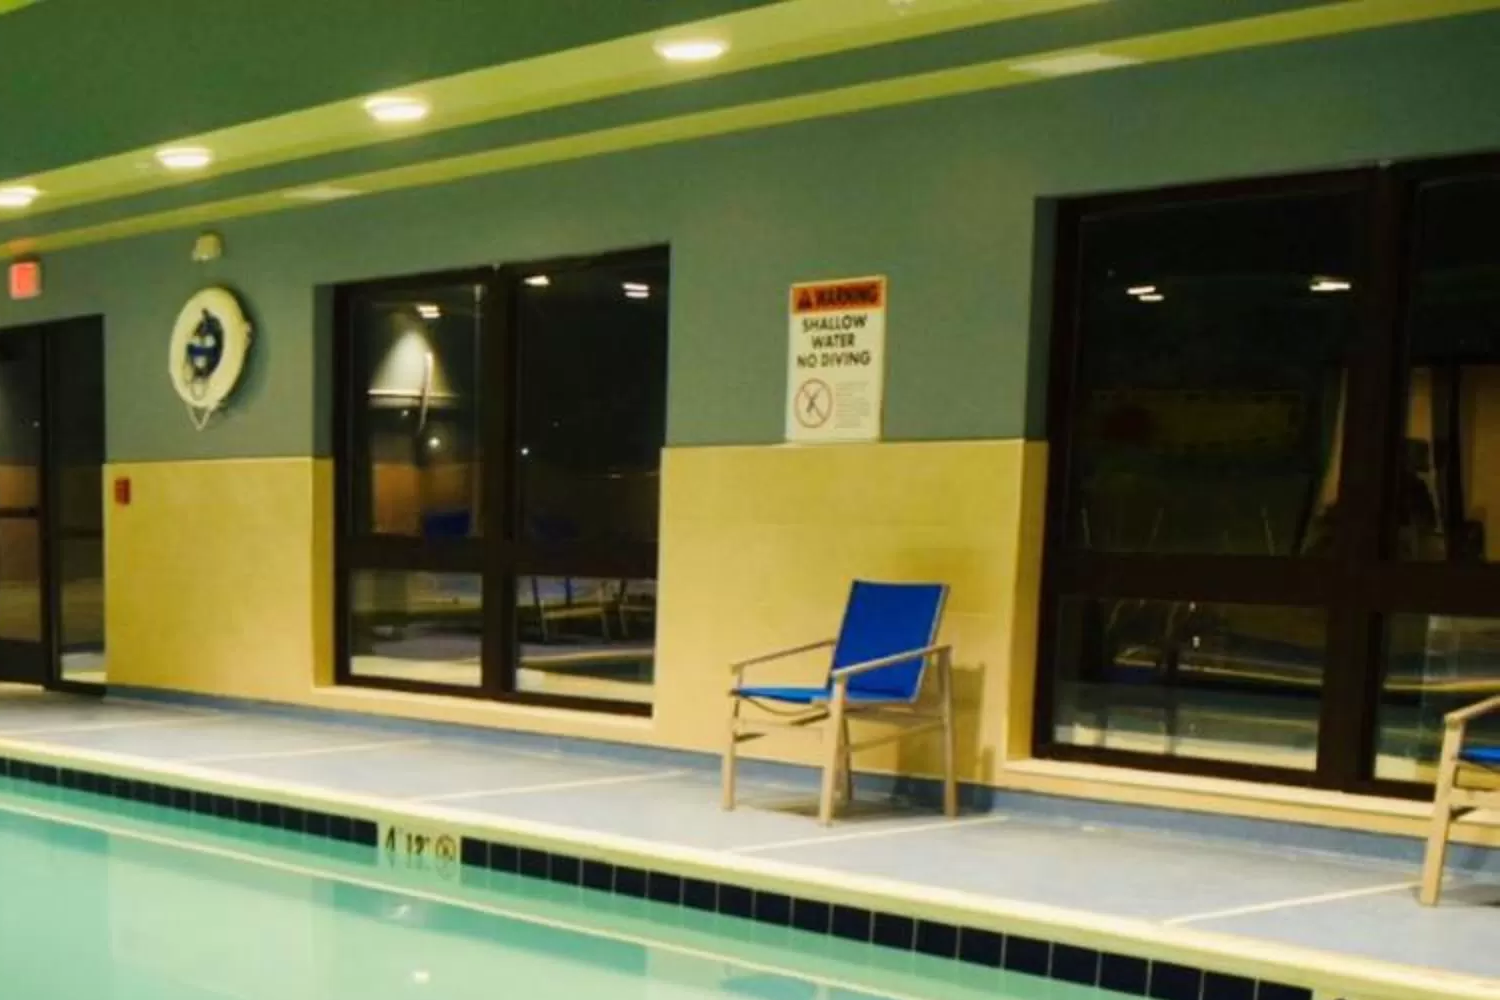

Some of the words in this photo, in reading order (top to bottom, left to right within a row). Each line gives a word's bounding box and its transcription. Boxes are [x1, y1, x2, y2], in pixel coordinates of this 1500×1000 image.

[817, 283, 878, 307] WARNING
[802, 314, 867, 332] SHALLOW
[812, 332, 855, 349] WATER
[797, 354, 817, 368] NO
[821, 350, 871, 367] DIVING
